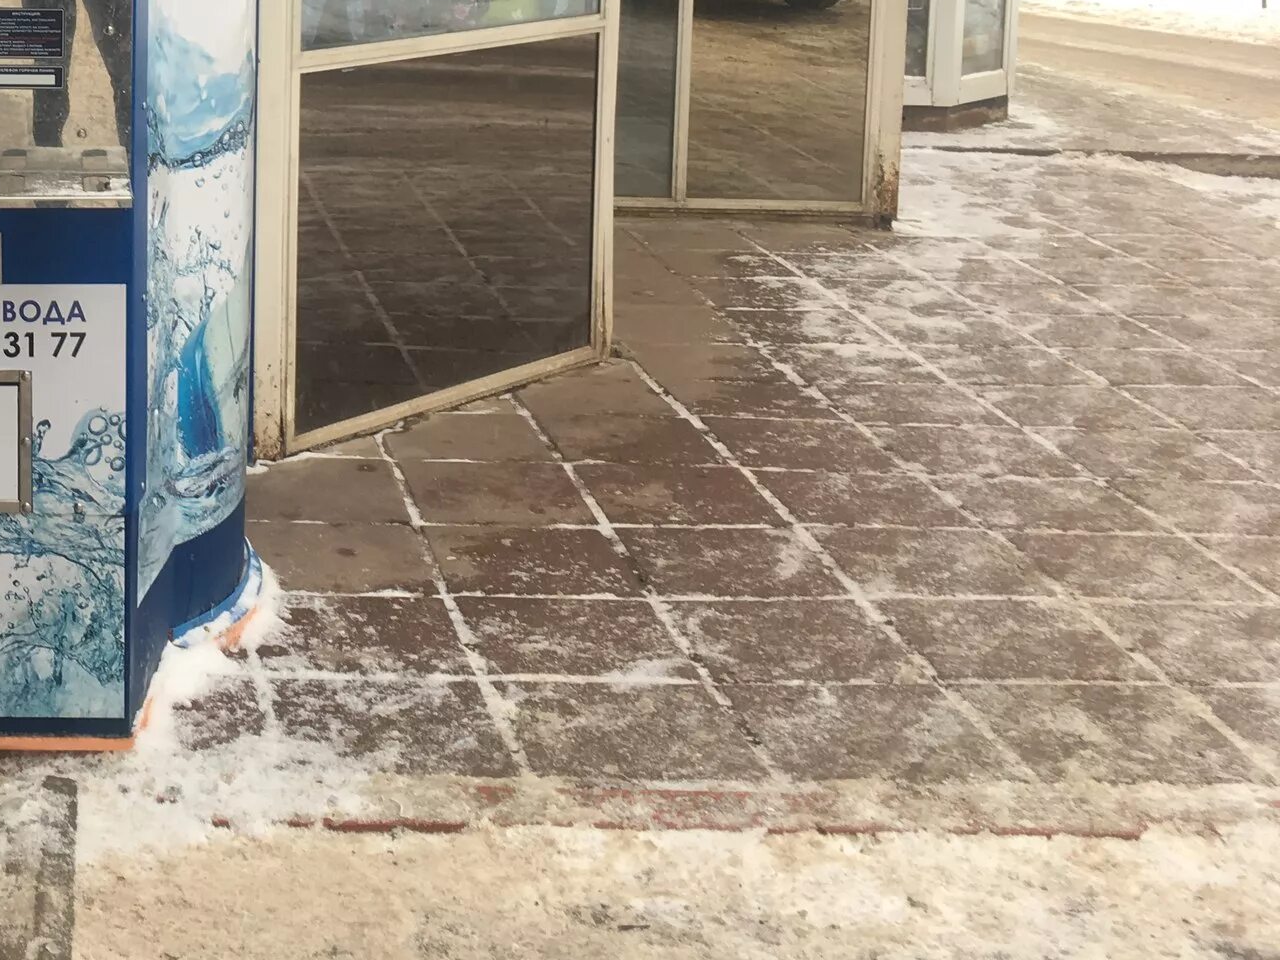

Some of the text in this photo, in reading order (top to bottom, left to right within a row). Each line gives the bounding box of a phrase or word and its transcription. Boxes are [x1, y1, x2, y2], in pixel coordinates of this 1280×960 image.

[2, 299, 87, 325] ВОДА
[2, 331, 37, 358] 31
[50, 331, 87, 358] 77
